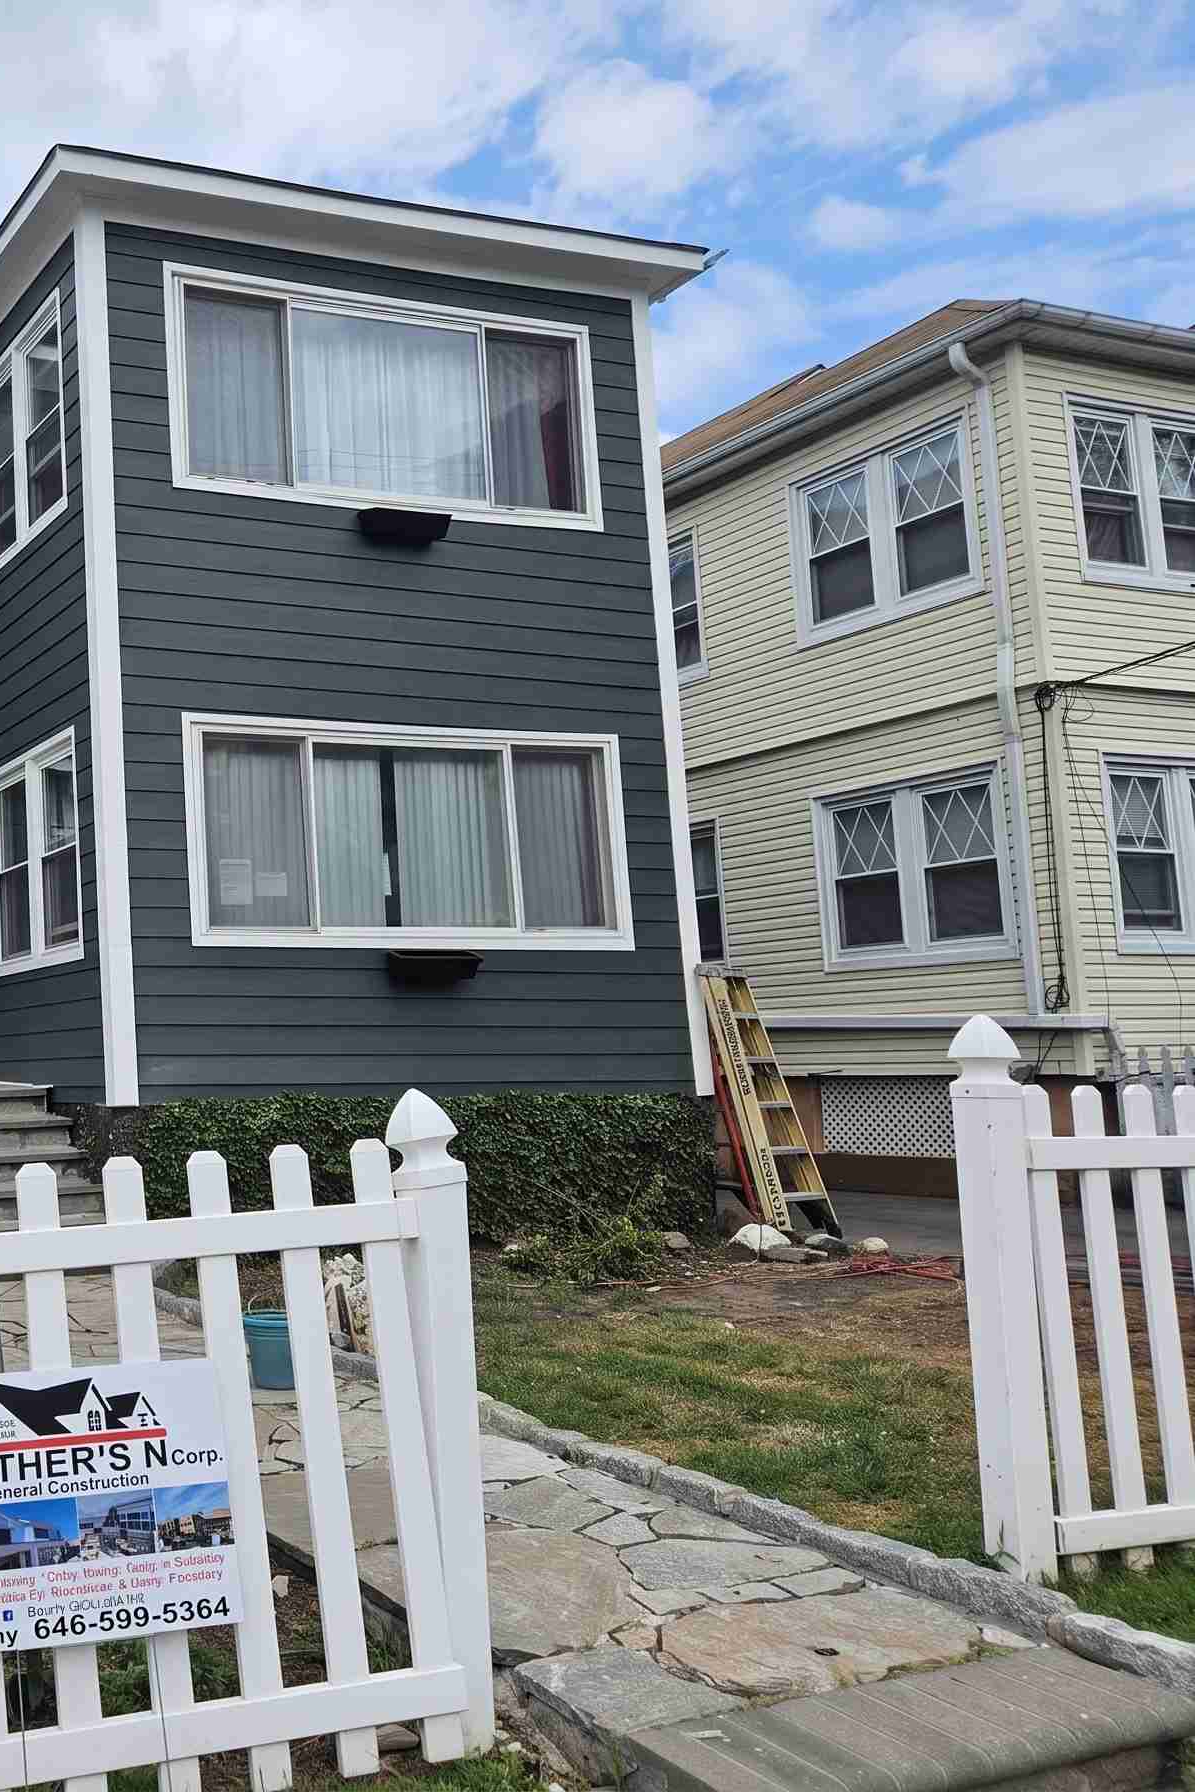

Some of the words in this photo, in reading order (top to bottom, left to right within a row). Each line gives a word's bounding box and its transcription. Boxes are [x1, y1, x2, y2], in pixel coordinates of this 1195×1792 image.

[144, 1440, 167, 1468] N
[172, 1448, 223, 1466] Corp.
[48, 1473, 149, 1494] Construction
[34, 1596, 230, 1640] 646-599-5364
